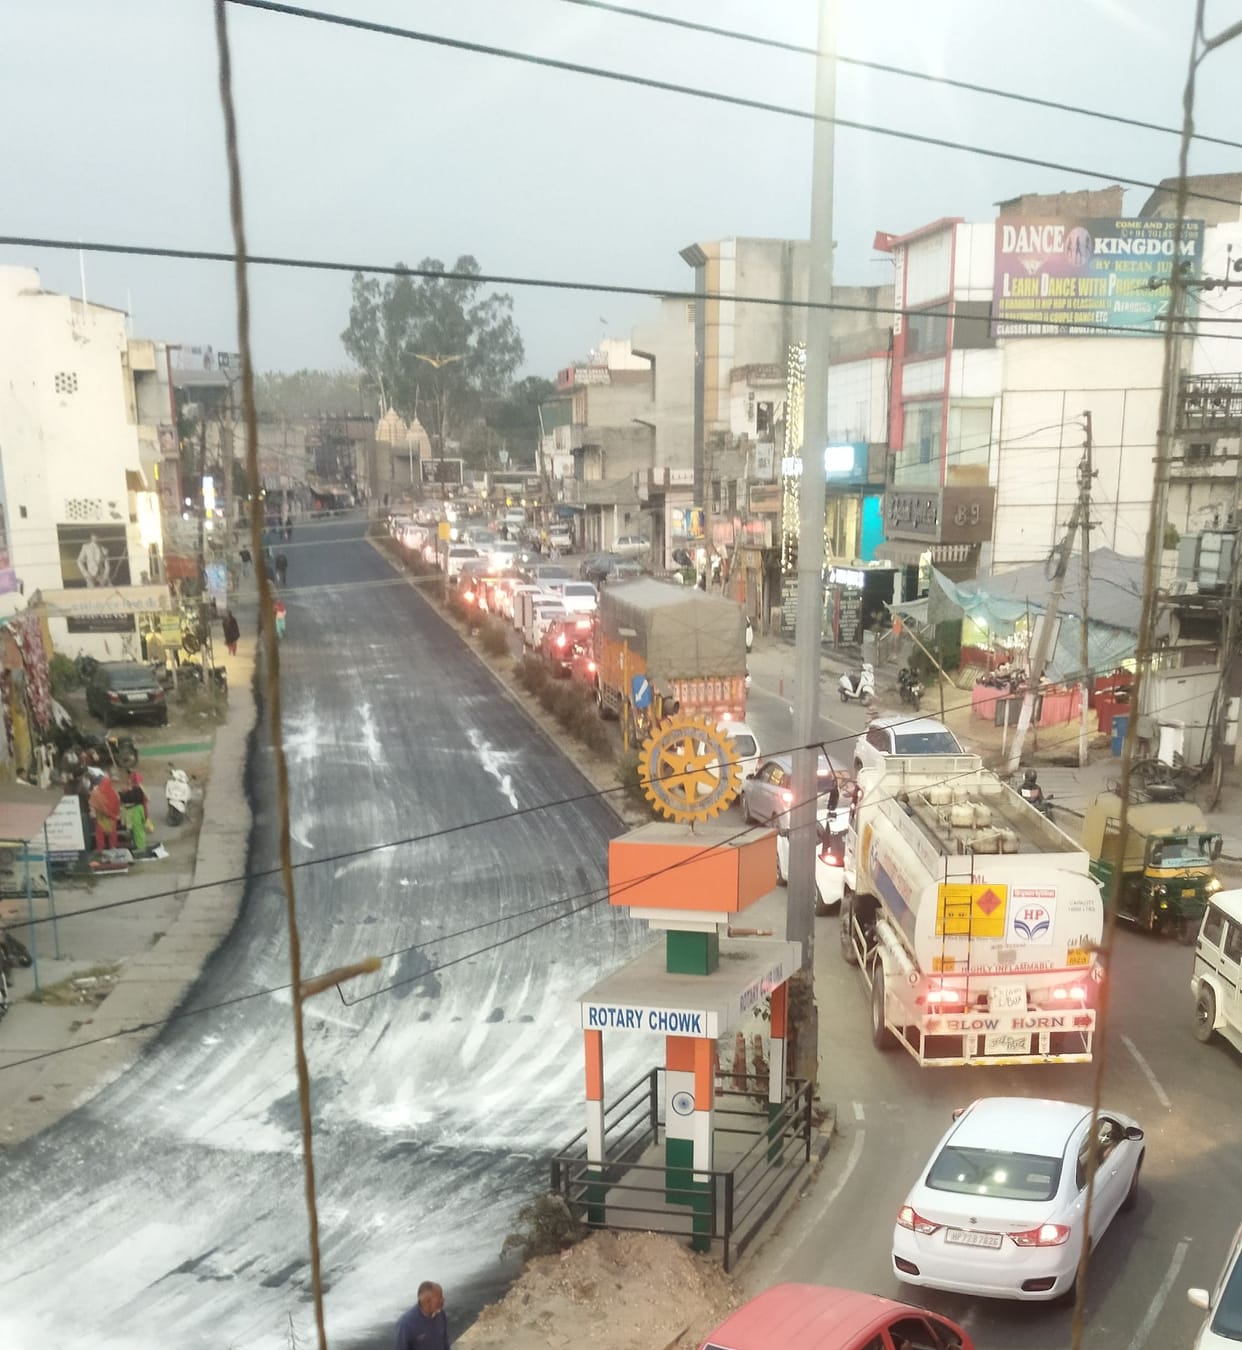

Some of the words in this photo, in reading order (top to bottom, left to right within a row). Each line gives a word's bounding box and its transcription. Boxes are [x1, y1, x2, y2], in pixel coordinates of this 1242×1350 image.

[1144, 222, 1163, 230] AND
[1002, 225, 1065, 254] DANCE
[1094, 237, 1196, 256] KINGDOM
[1096, 259, 1111, 270] BY
[1003, 273, 1040, 297] LEARN
[1041, 273, 1077, 297] DANCE
[1078, 277, 1107, 297] WITH
[1095, 312, 1109, 323] ETC
[1023, 908, 1045, 921] HP
[588, 1006, 643, 1028] ROTARY
[648, 1010, 702, 1034] CHOWK
[947, 1019, 1000, 1031] BLOW
[1011, 1016, 1065, 1029] HORN
